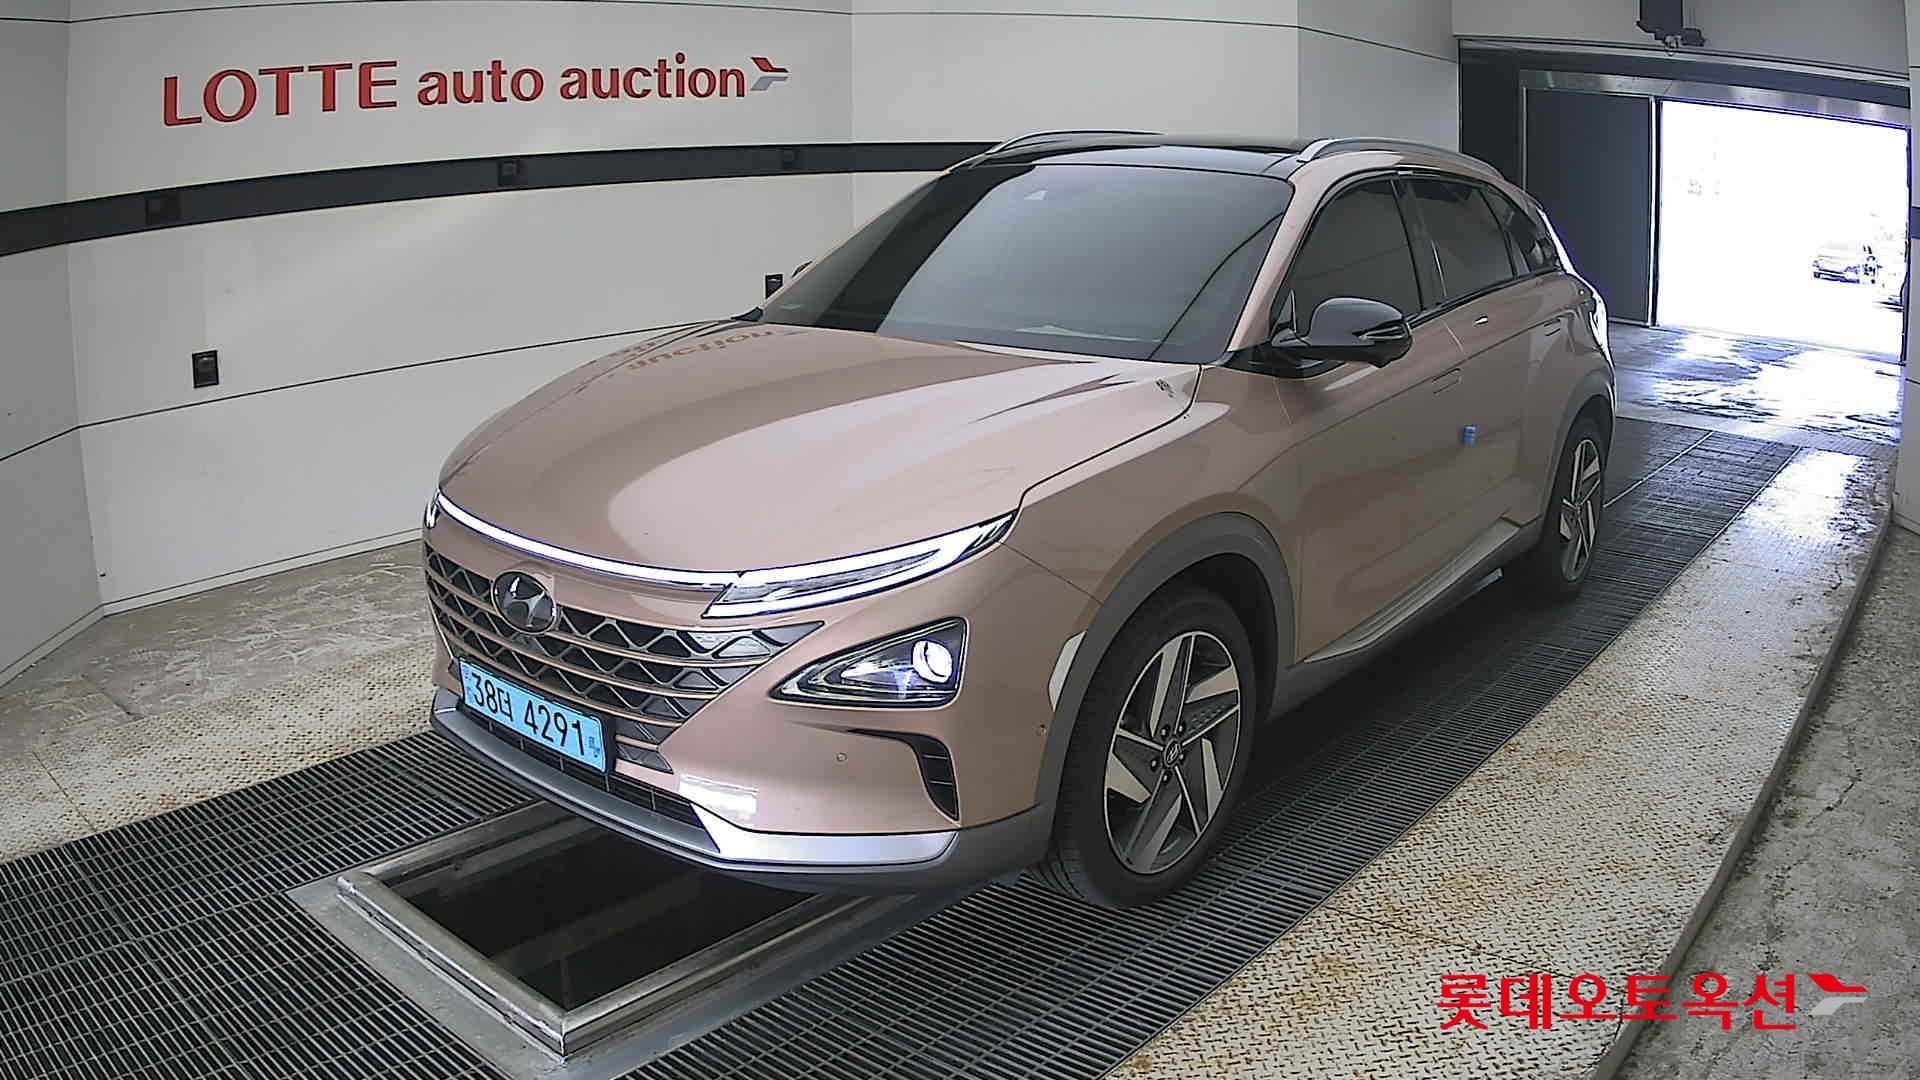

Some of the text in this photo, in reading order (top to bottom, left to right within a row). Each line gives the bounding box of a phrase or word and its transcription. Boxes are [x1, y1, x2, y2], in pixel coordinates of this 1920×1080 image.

[163, 52, 746, 127] LOTTE auto auction
[471, 672, 514, 722] 38더
[523, 699, 585, 756] 4291
